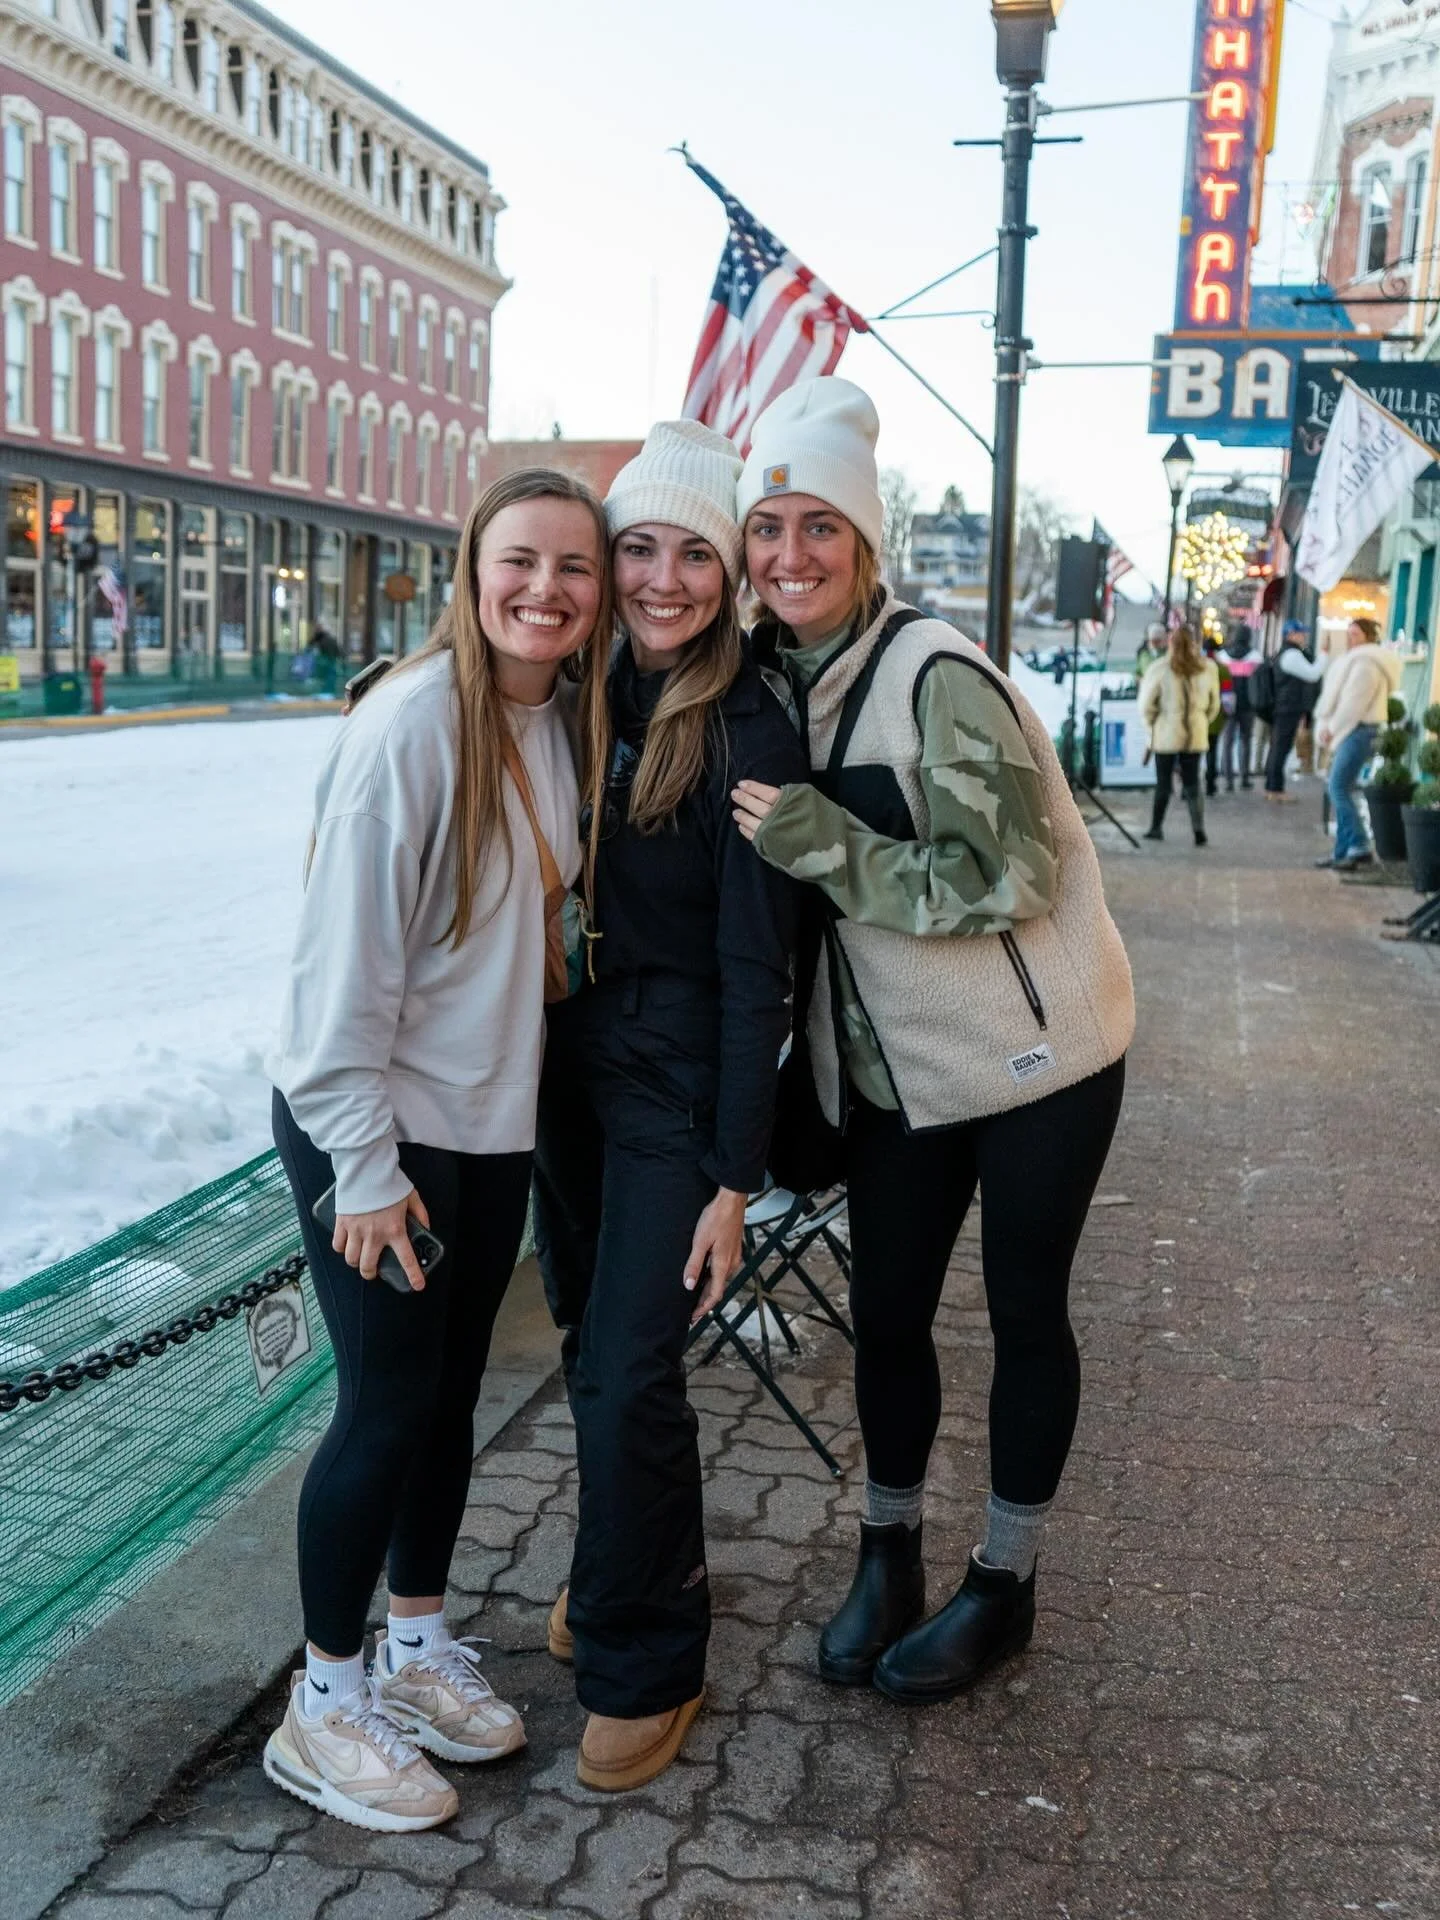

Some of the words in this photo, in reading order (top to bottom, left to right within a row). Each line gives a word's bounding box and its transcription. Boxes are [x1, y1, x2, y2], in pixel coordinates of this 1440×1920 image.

[1167, 347, 1358, 419] BA
[1305, 381, 1440, 428] LEVILLE
[1012, 1054, 1031, 1066] EDDIE
[1015, 1058, 1036, 1071] BAUER
